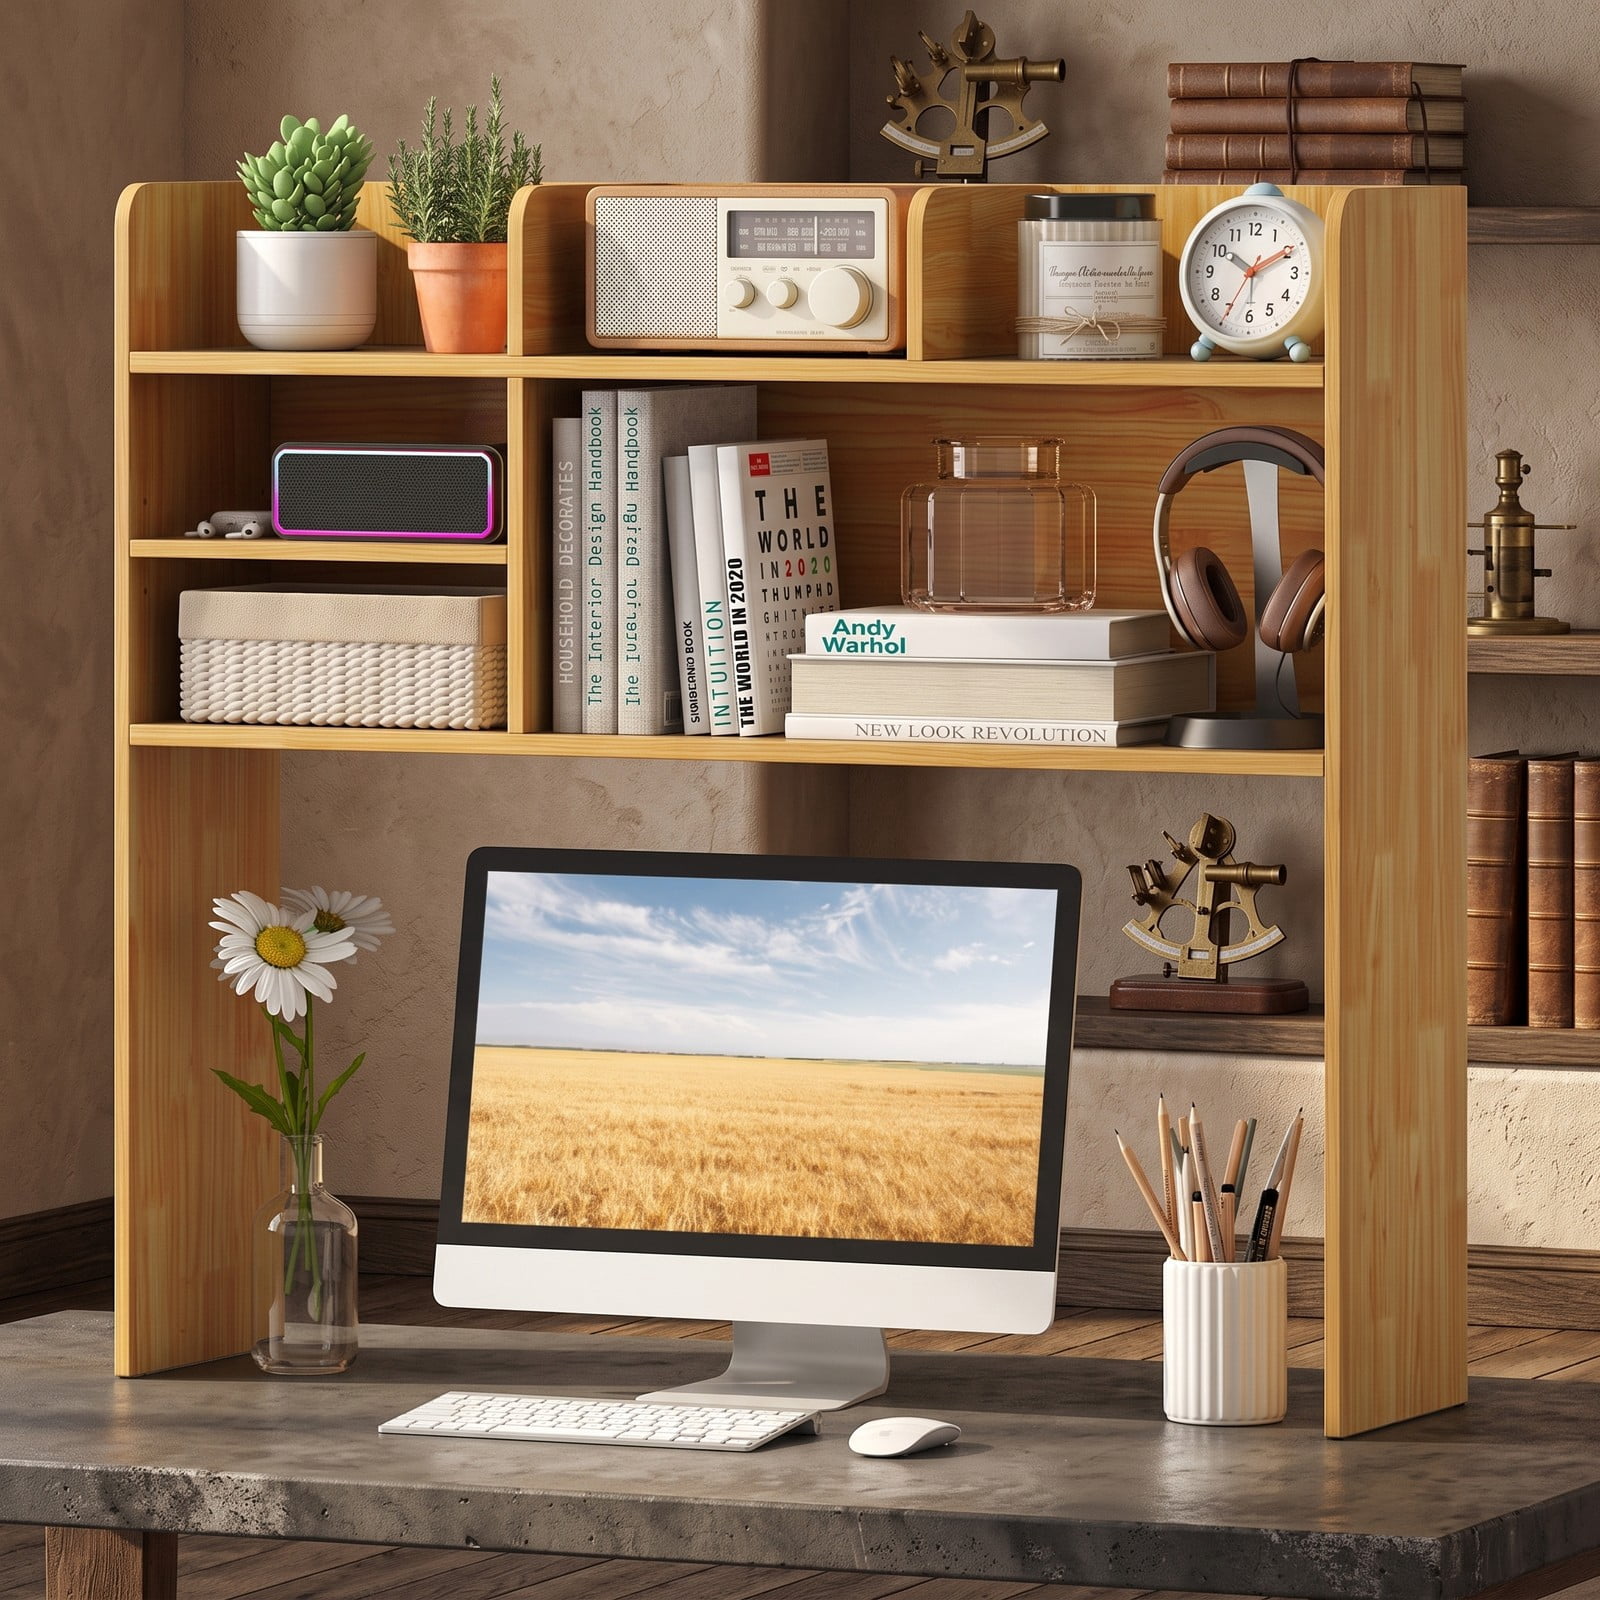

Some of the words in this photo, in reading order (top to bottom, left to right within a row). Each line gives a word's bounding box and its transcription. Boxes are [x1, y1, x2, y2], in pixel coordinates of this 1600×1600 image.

[1230, 229, 1241, 242] 11
[1249, 222, 1262, 236] 12
[1273, 229, 1278, 242] 1
[1212, 244, 1227, 258] 10
[1206, 265, 1214, 278] 9
[1290, 266, 1299, 280] 3
[1211, 287, 1220, 301] 8
[1281, 288, 1290, 302] 4
[1245, 310, 1254, 323] 6
[1265, 303, 1274, 317] 5
[588, 407, 602, 491] Handbook
[558, 461, 574, 566] DECORATES
[754, 485, 827, 522] THE
[588, 503, 606, 566] Design
[758, 526, 829, 553] WORLD
[760, 561, 779, 579] IN
[785, 555, 831, 578] 2020
[727, 558, 746, 604] 2020
[761, 582, 833, 603] THUMPHD
[588, 578, 602, 662] Interior
[731, 607, 747, 626] IN
[559, 578, 574, 684] HOUSEHOLD
[683, 621, 694, 654] BOOK
[832, 618, 896, 640] Andy
[821, 636, 906, 654] Warhol
[705, 600, 732, 726] INTUITION
[733, 629, 751, 692] WORLD
[588, 674, 602, 706] The
[738, 696, 755, 728] THE
[855, 723, 902, 738] NEW
[908, 724, 966, 739] LOOK
[973, 726, 1107, 743] REVOLUTION
